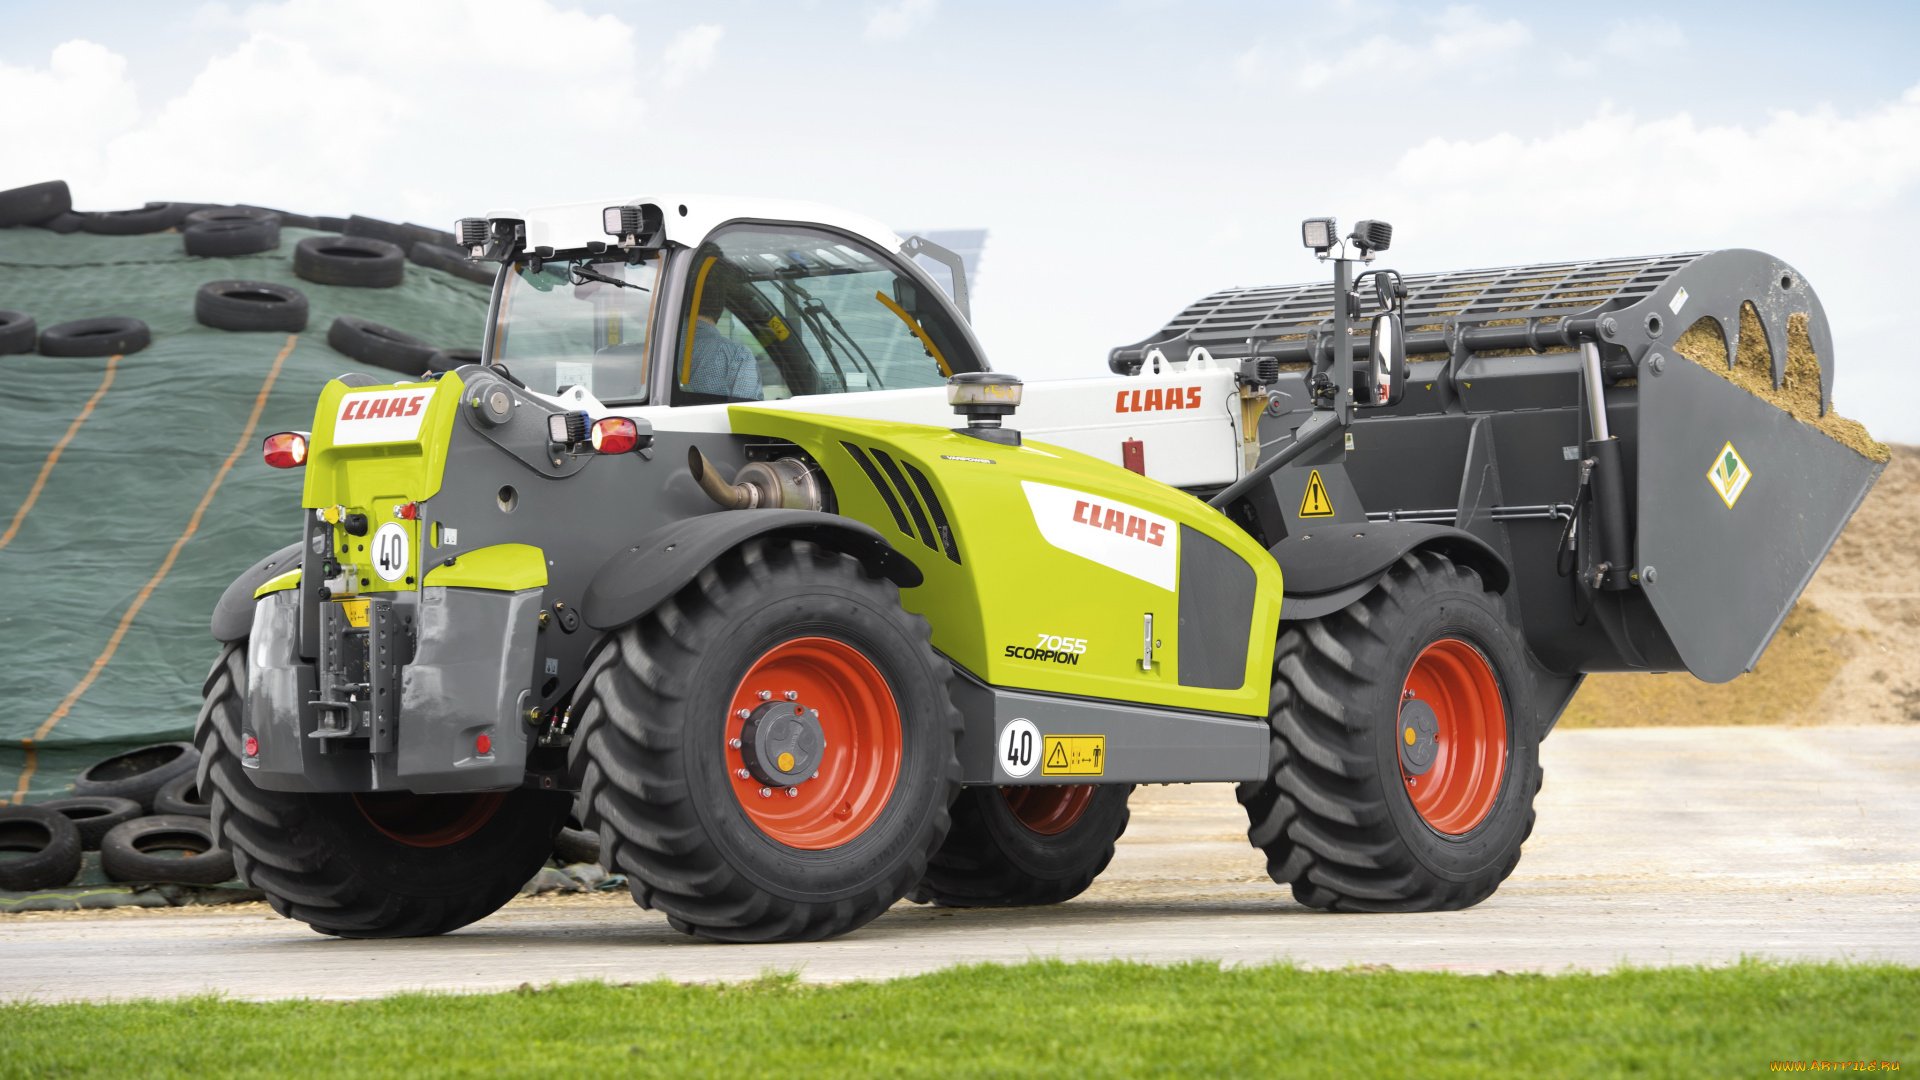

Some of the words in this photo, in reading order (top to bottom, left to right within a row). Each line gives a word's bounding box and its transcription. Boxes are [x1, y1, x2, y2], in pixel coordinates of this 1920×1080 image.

[341, 395, 426, 421] CLAAS
[1115, 386, 1202, 413] CLAAS
[1072, 500, 1166, 547] CLAAS
[380, 533, 402, 571] 40
[1004, 645, 1080, 666] SCORPION
[1035, 633, 1088, 655] 7055
[1007, 729, 1033, 767] 40
